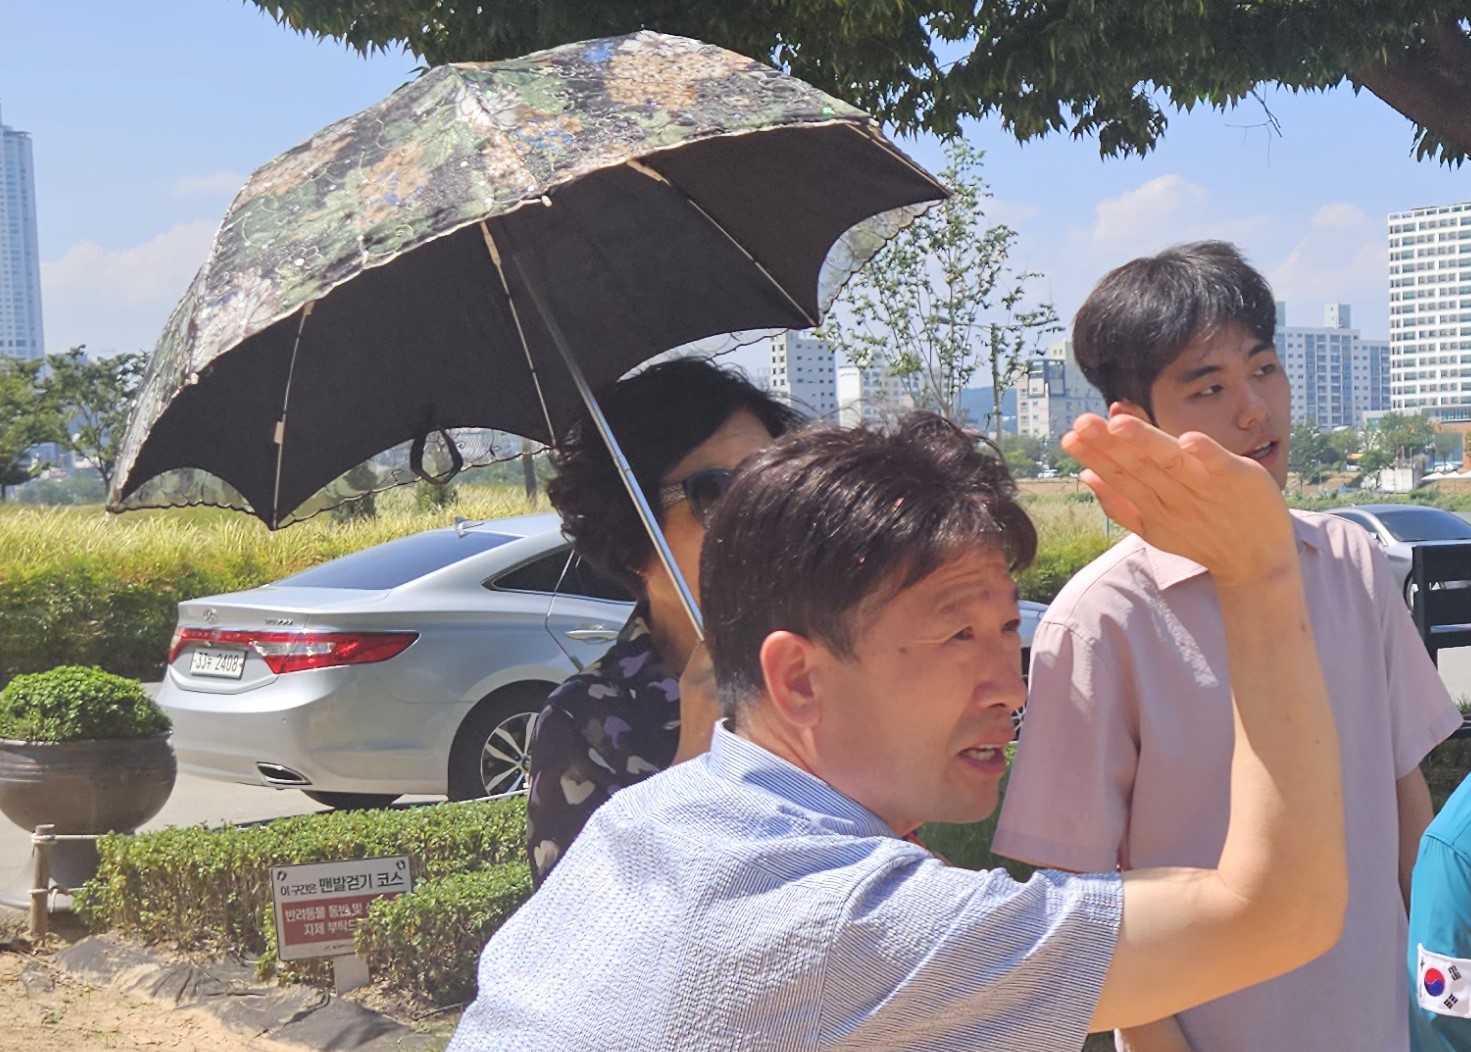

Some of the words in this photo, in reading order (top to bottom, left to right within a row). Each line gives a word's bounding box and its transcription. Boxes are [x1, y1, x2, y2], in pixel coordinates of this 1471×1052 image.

[215, 653, 239, 671] 2408
[319, 873, 372, 893] 맨발걷기
[376, 872, 404, 887] 코스
